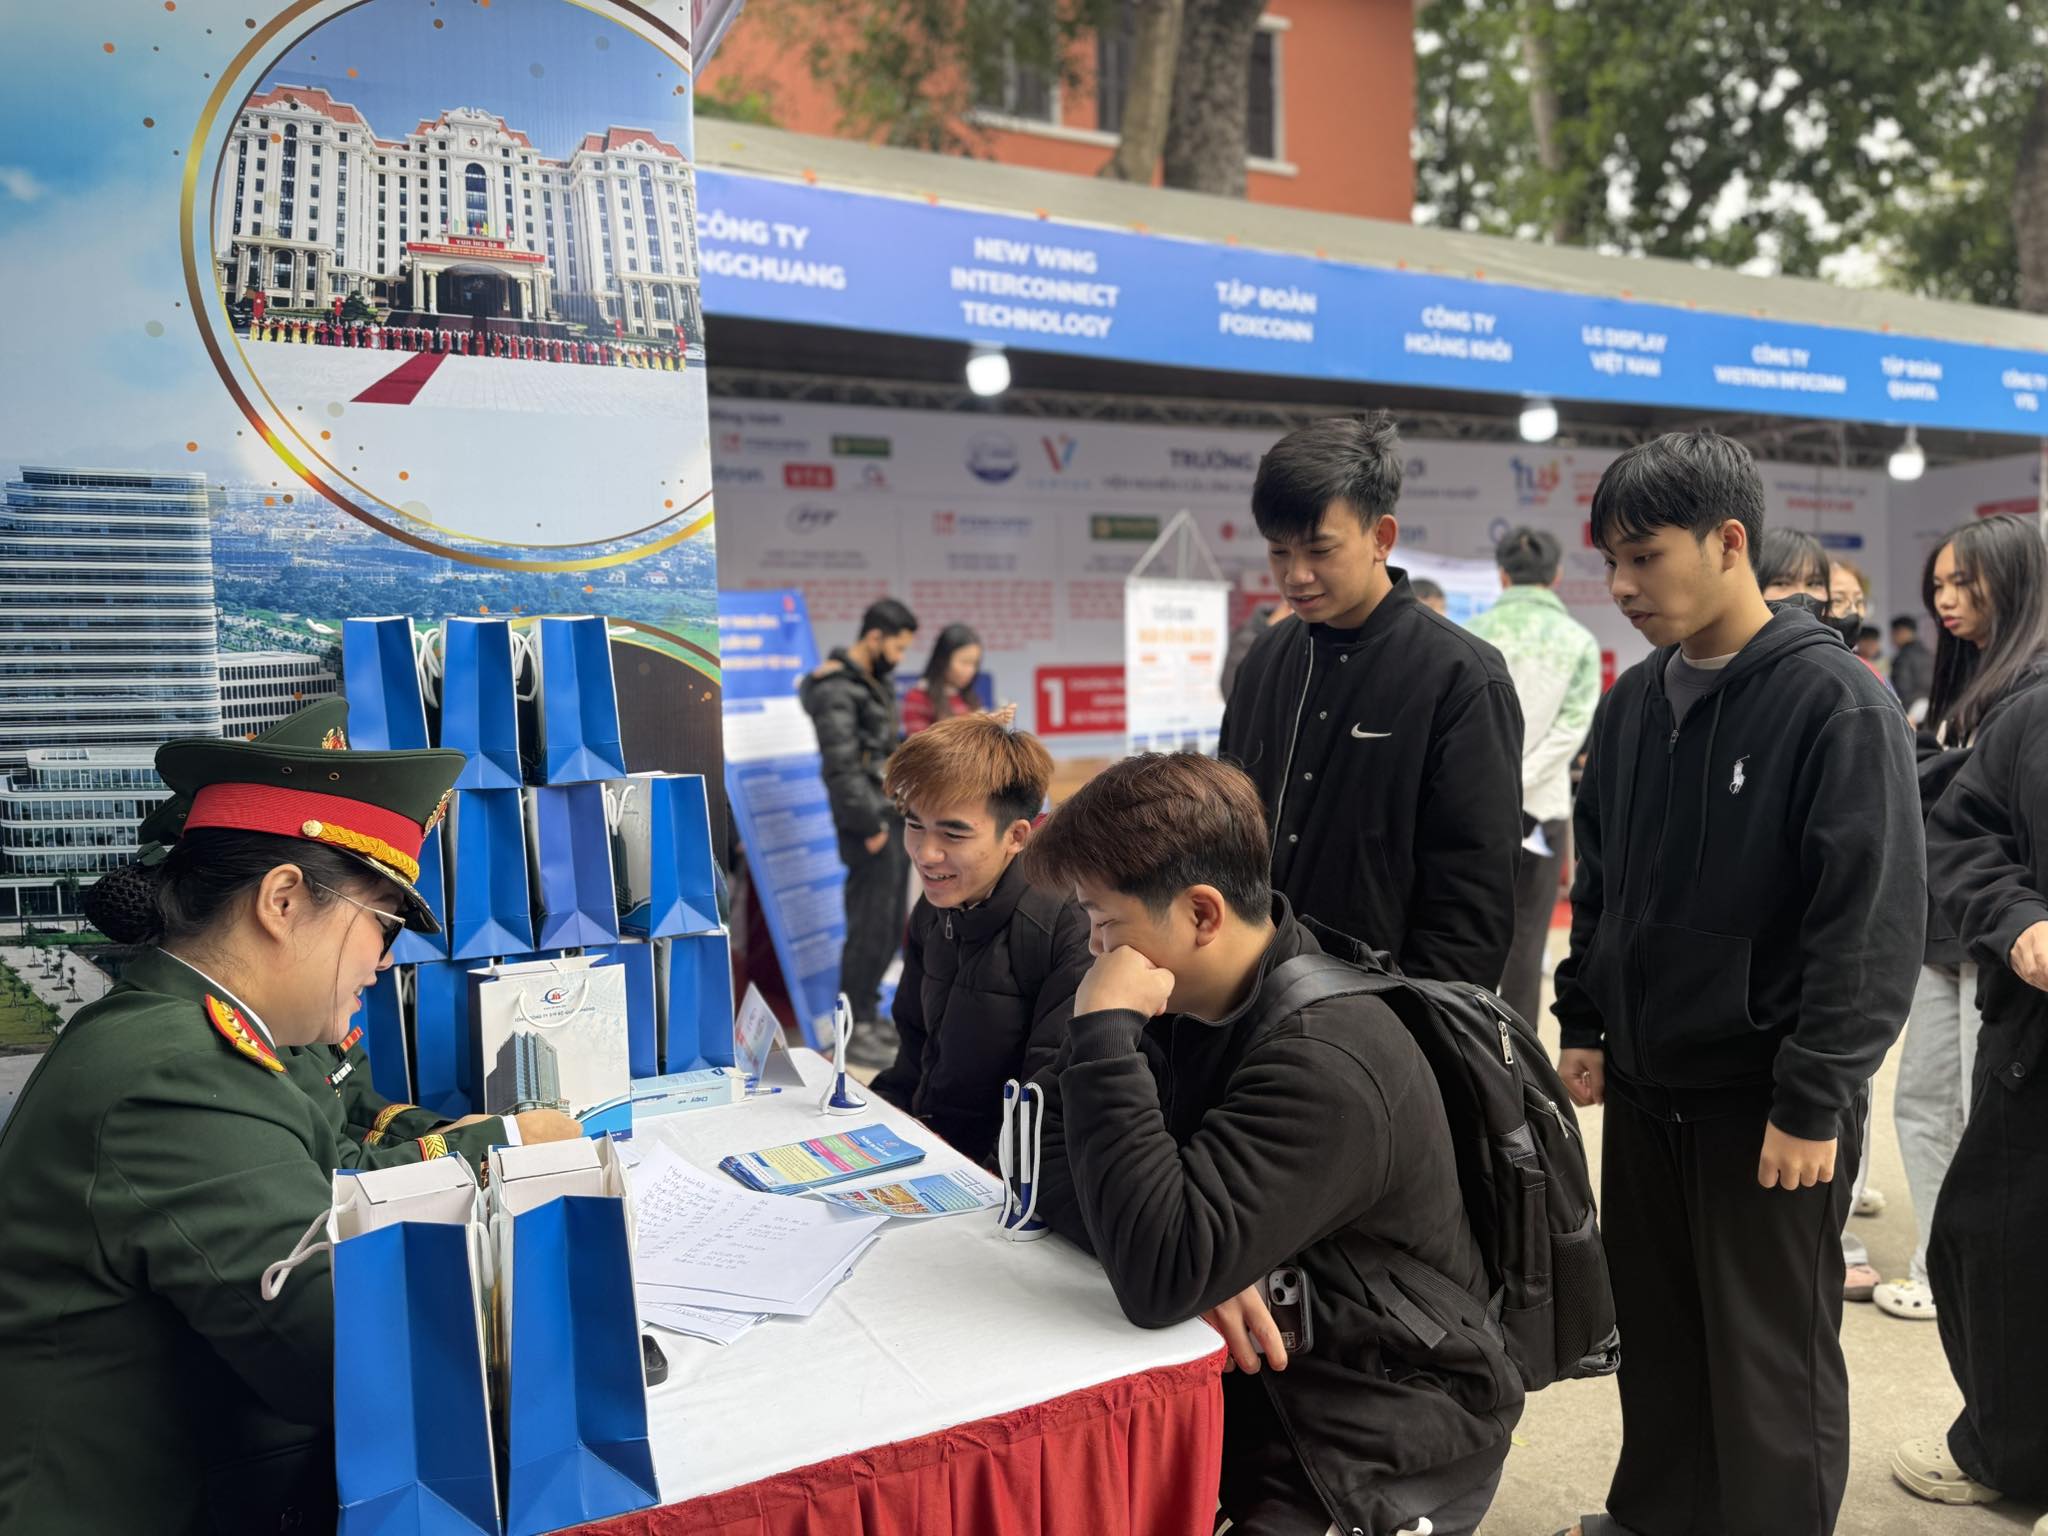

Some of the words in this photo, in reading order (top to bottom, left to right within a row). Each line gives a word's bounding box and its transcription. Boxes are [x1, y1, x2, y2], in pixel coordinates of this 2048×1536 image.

[696, 208, 770, 246] CÔNG
[771, 221, 811, 250] TY
[696, 248, 847, 290] NGCHUANG
[972, 235, 1031, 266] NEW
[1032, 244, 1099, 275] WING
[950, 265, 1120, 309] INTERCONNECT
[960, 299, 1113, 339] TECHNOLOGY
[1218, 311, 1315, 343] FOXCONN
[1473, 312, 1497, 335] TY
